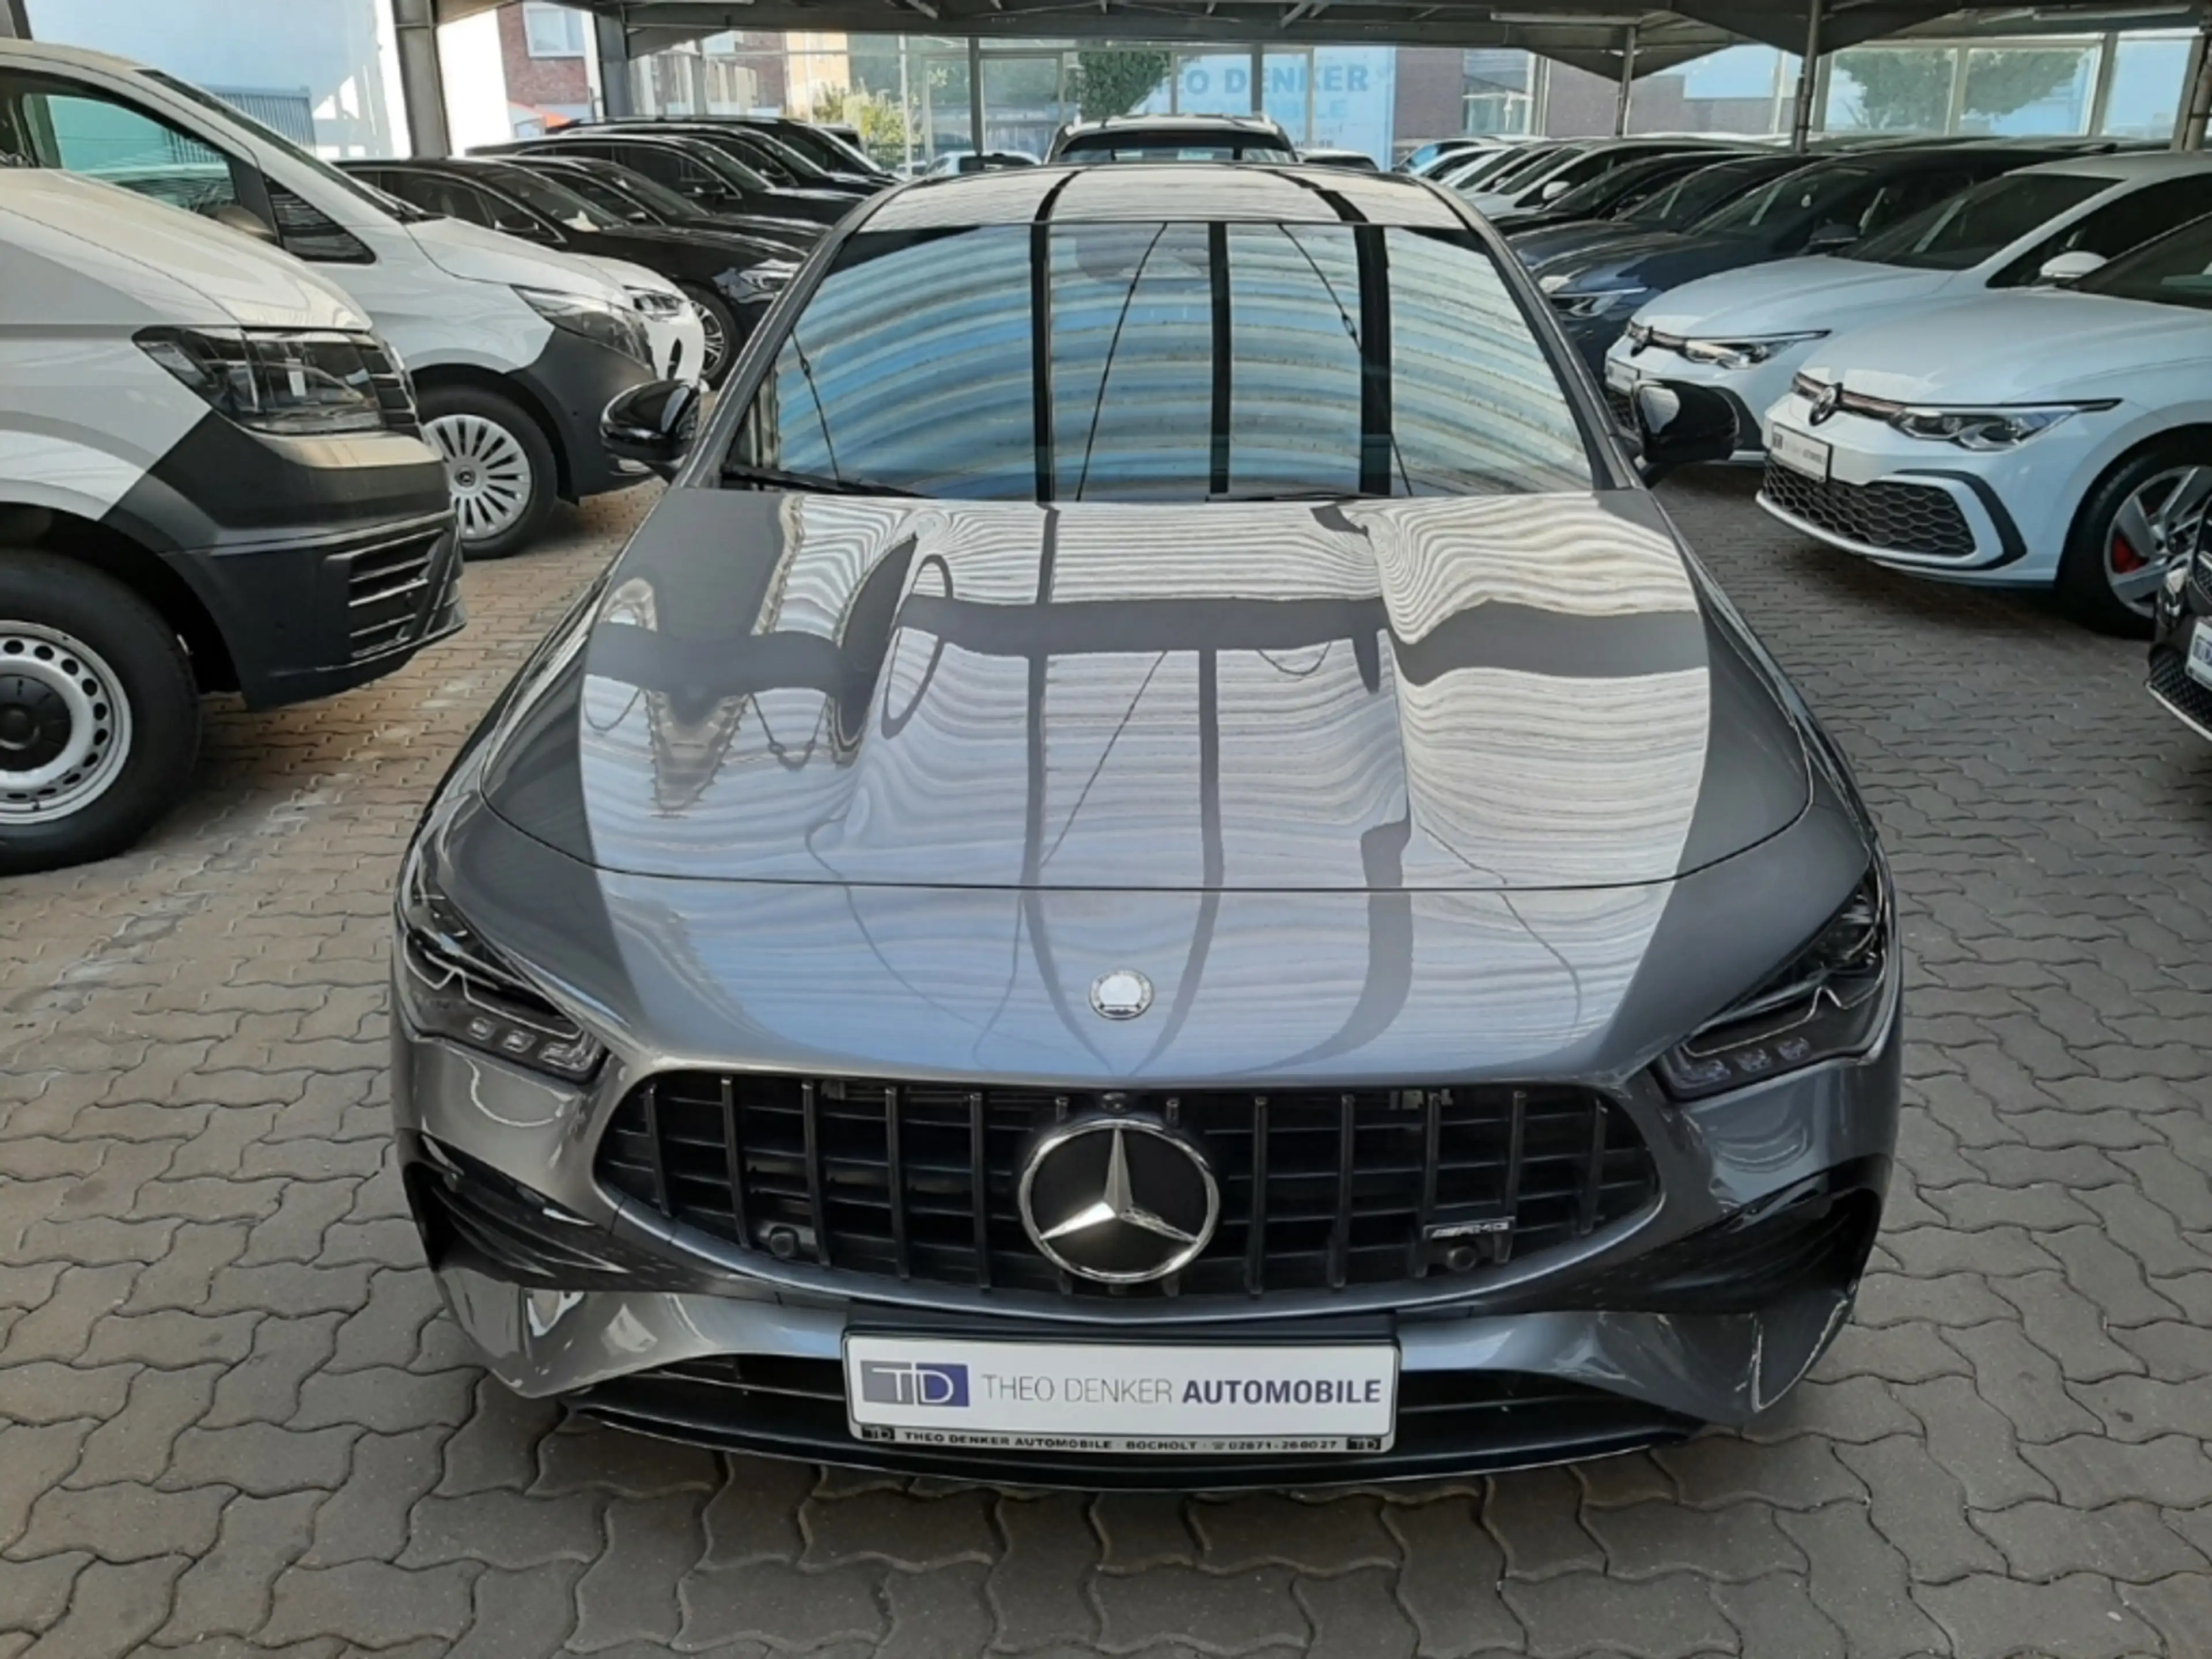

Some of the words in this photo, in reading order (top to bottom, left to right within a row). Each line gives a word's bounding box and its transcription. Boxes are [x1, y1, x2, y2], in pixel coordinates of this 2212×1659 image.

[981, 1374, 1055, 1402] THEO
[1064, 1377, 1172, 1404] DENKER
[1181, 1380, 1381, 1404] AUTOMOBILE
[904, 1431, 944, 1444] THEO
[948, 1434, 1009, 1445] DENKER
[1014, 1437, 1112, 1449] AUTOMOBILE
[1126, 1441, 1198, 1450] BOCHOLT
